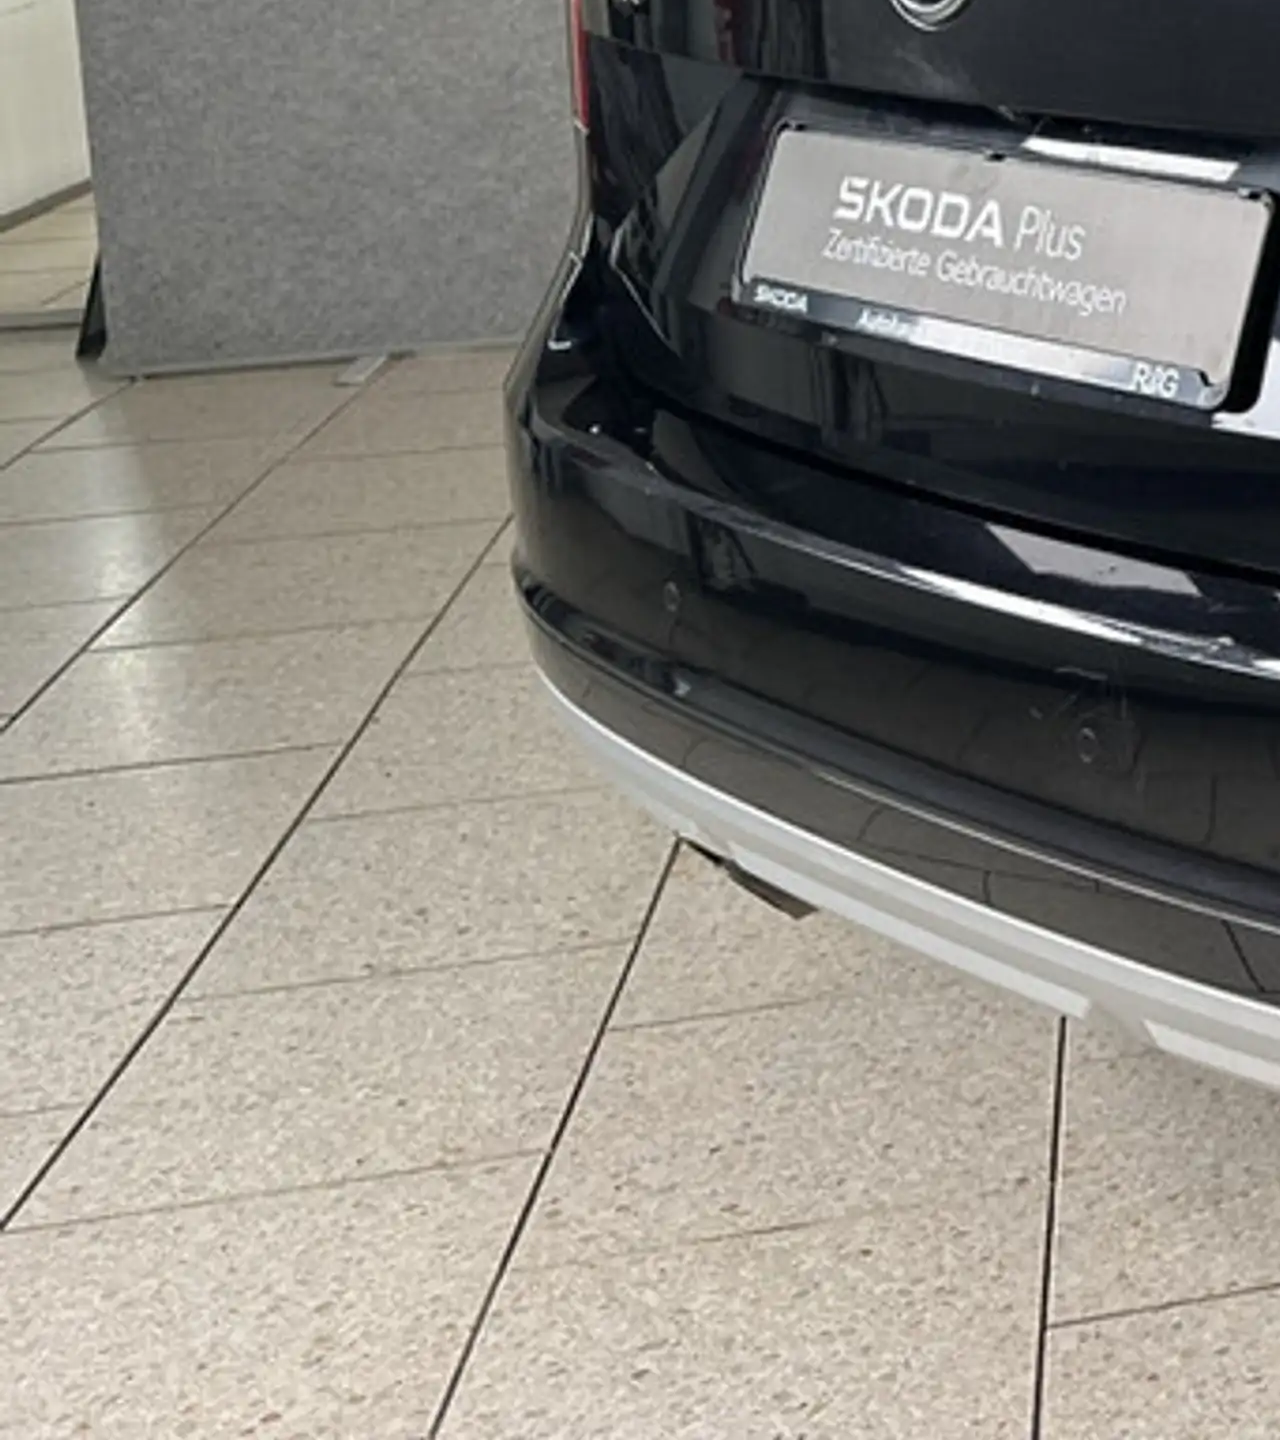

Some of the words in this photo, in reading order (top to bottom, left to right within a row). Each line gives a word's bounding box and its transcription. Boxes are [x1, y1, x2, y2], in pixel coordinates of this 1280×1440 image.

[833, 175, 1005, 248] SKODA
[1014, 205, 1087, 261] Plus
[821, 228, 931, 277] Zertifizierte
[936, 249, 1127, 316] Gebrauchtwagen
